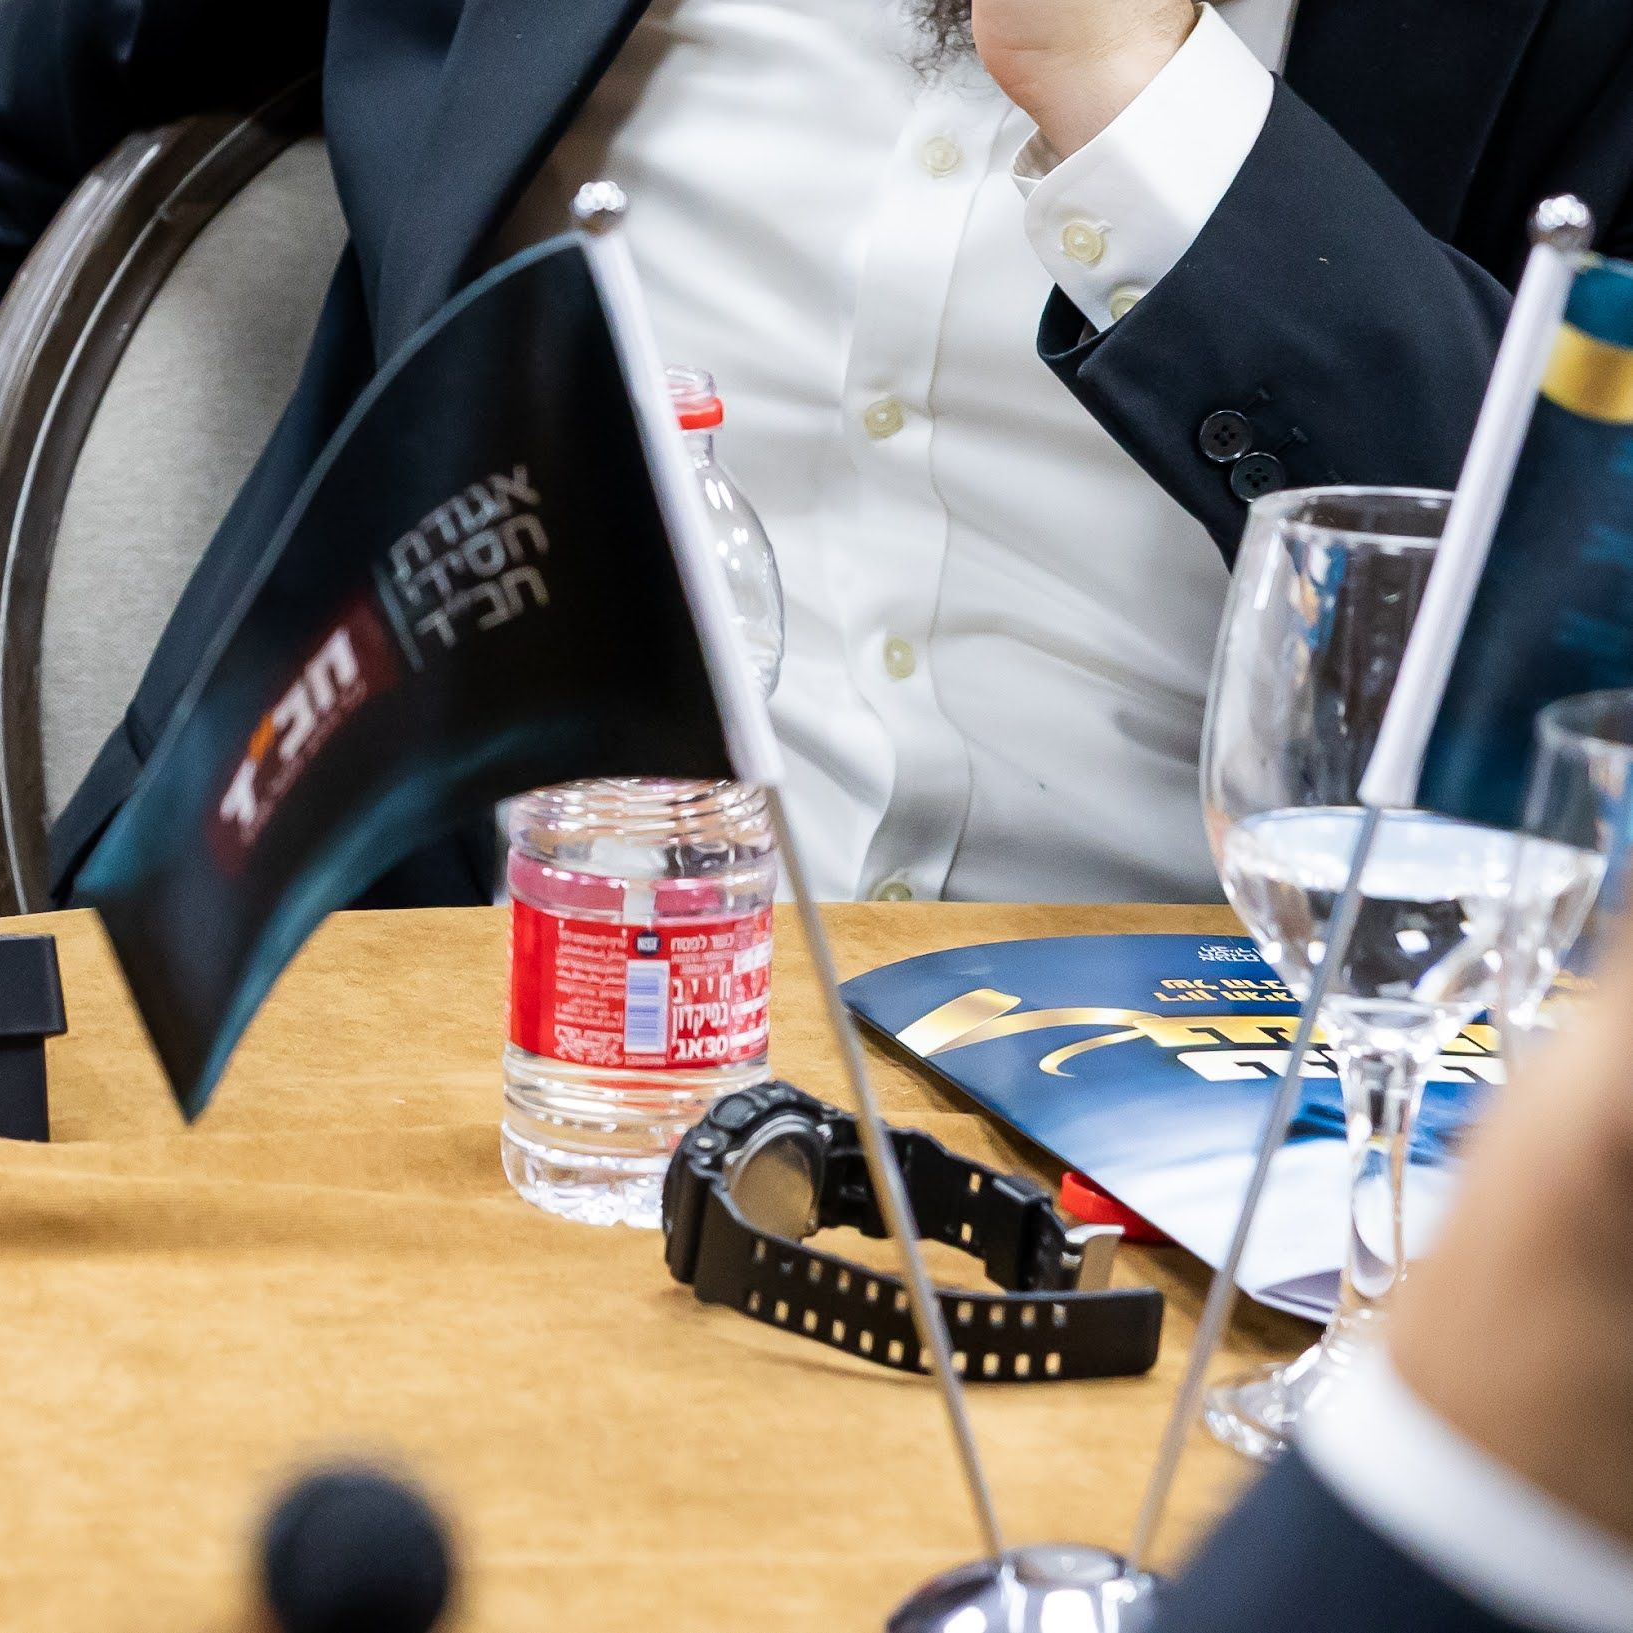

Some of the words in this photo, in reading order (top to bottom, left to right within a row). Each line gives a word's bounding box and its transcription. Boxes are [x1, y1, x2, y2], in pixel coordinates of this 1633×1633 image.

[1159, 978, 1219, 990] של
[1153, 988, 1218, 1002] דיון
[1218, 990, 1298, 1002] חגיג
